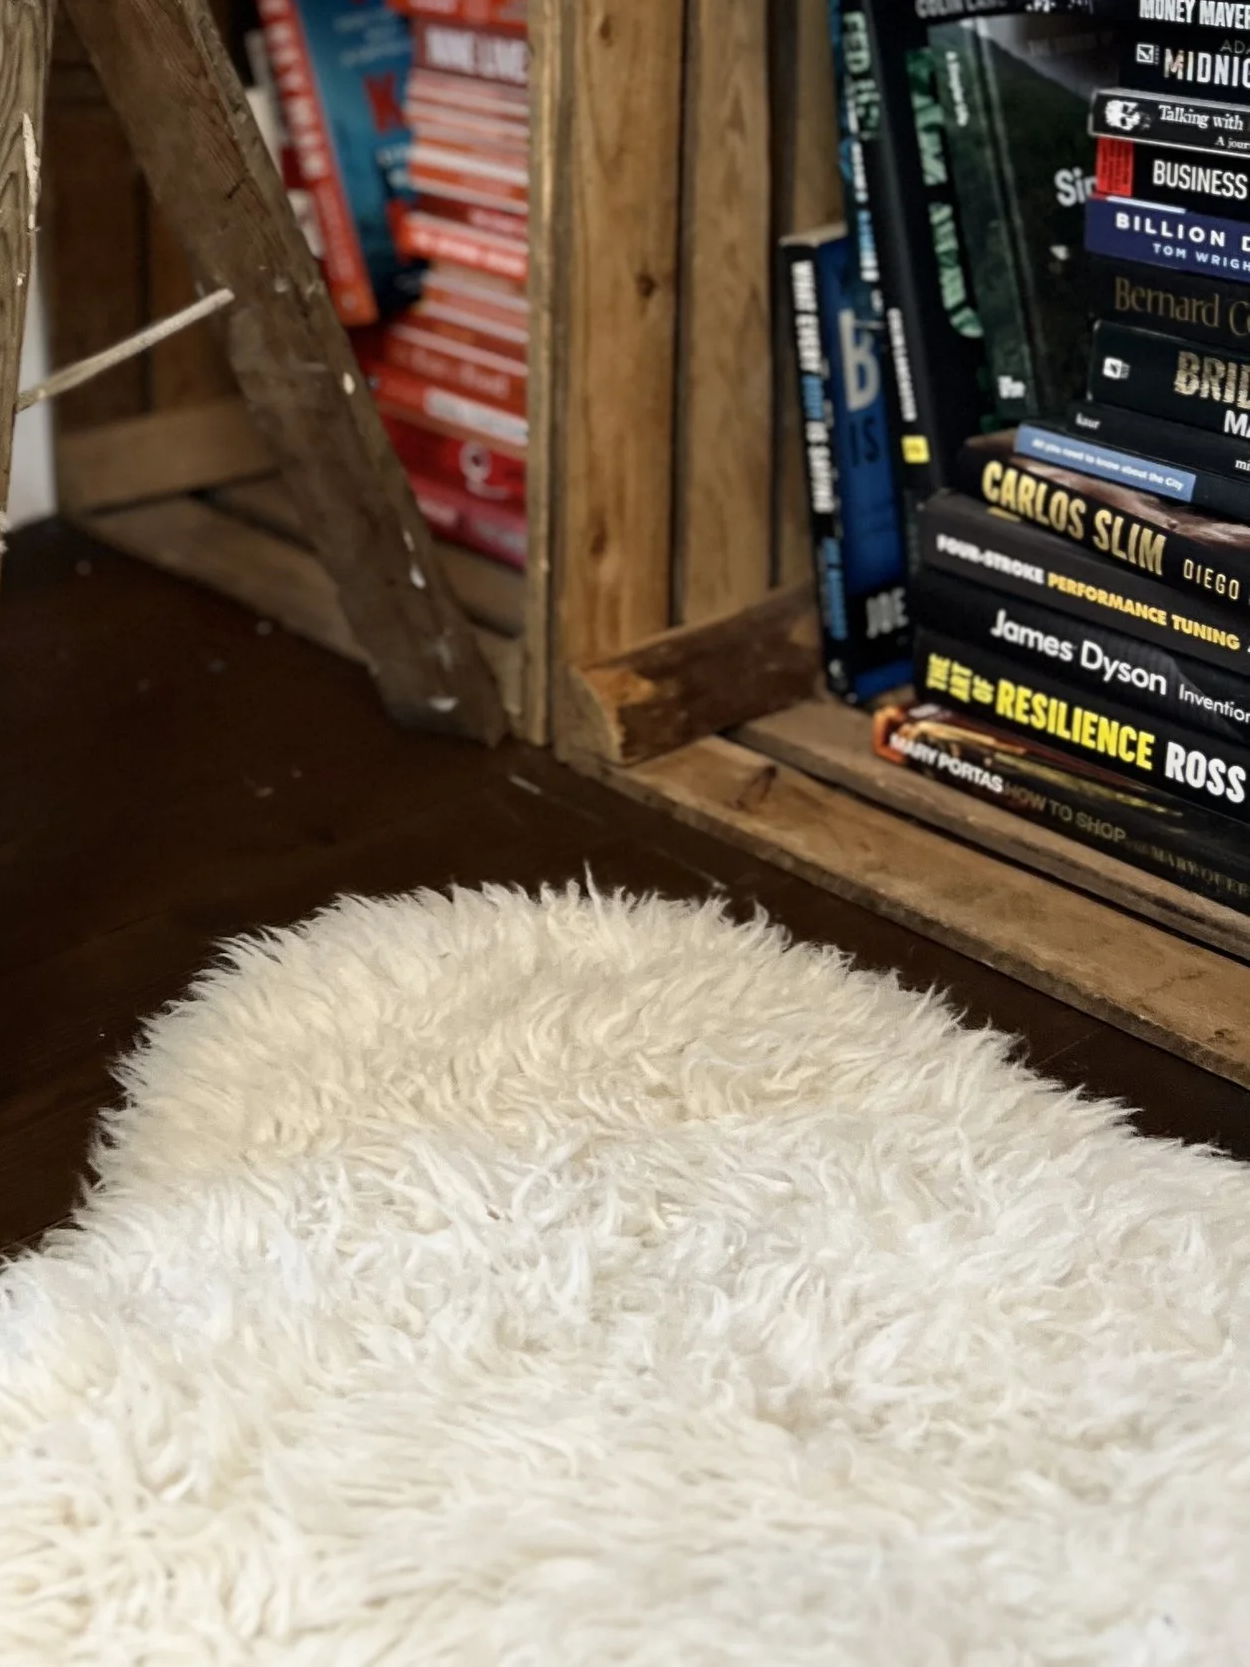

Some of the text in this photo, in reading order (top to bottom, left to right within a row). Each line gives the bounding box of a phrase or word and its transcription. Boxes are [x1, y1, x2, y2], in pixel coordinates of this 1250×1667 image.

[1158, 104, 1244, 132] Talking with
[1214, 135, 1226, 147] A
[1152, 159, 1249, 200] BUSINESS
[1114, 212, 1226, 248] BILLION
[1152, 242, 1188, 260] TOM
[1113, 275, 1221, 329] Bernard
[981, 459, 1241, 601] CARLOS SLIM DIEGO
[936, 533, 1242, 651] FOUR-STROKE PERFORMANCE TUNING
[990, 609, 1074, 663] James
[1081, 640, 1168, 696] Dyson
[995, 677, 1247, 804] RESILIENCE ROSS
[937, 752, 1006, 794] PORTAS
[1049, 794, 1074, 822] TO
[1074, 811, 1128, 844] SHOP
